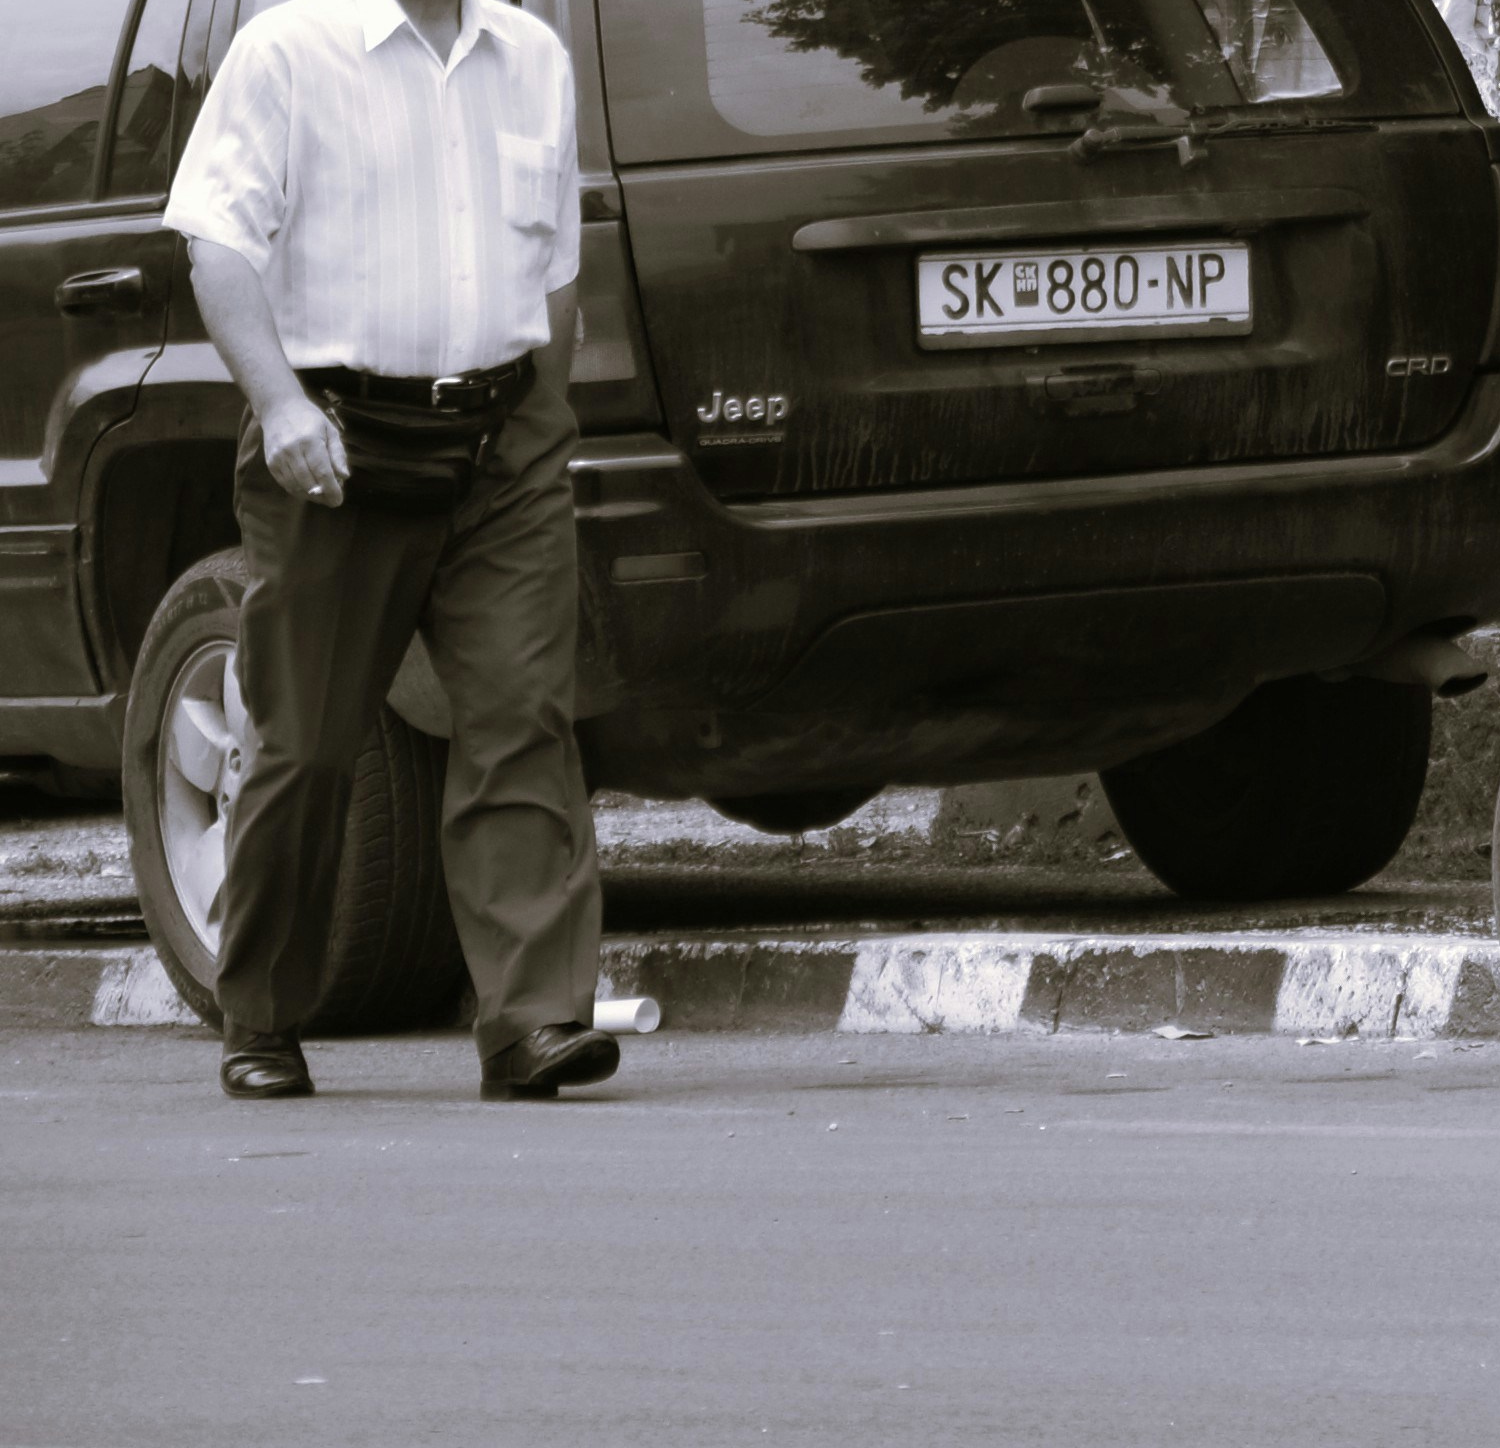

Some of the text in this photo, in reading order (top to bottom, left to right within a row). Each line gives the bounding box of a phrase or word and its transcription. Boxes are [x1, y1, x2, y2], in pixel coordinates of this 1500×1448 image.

[941, 253, 1225, 320] SK 880-NP
[1386, 356, 1451, 376] CRD
[697, 391, 789, 426] Jeep
